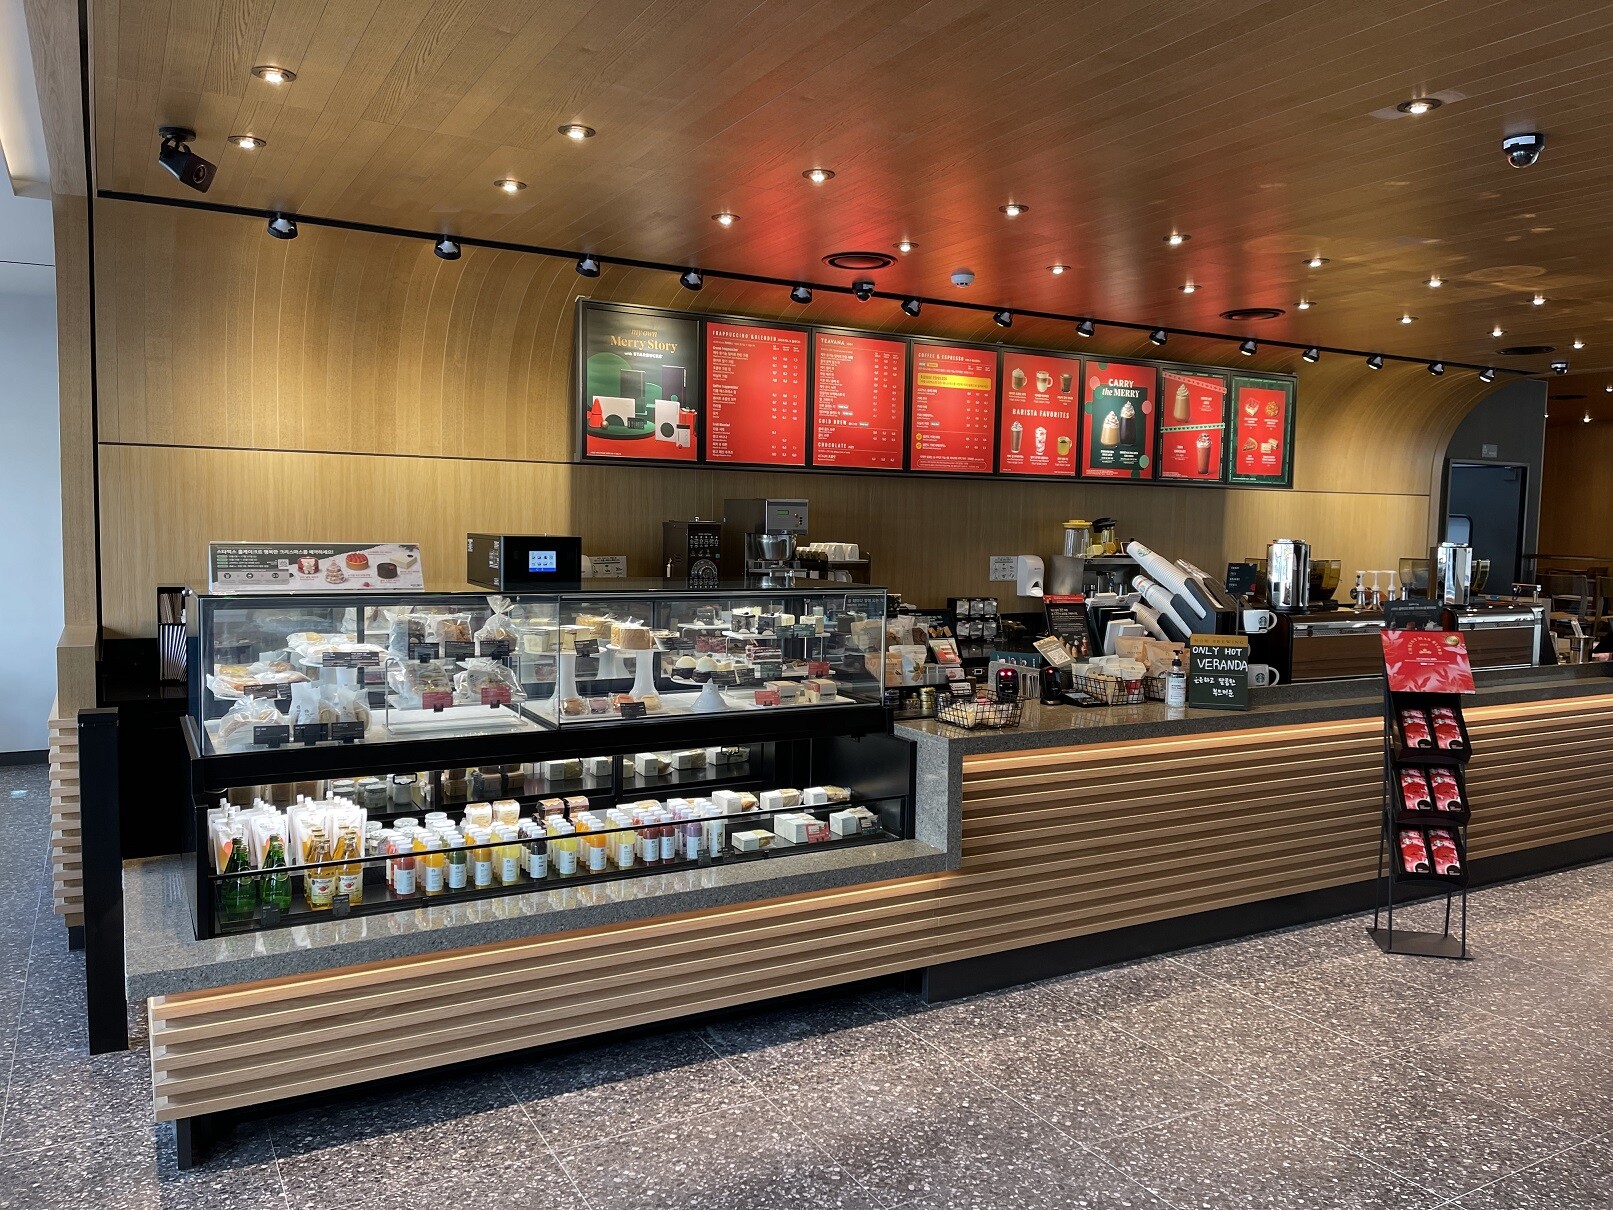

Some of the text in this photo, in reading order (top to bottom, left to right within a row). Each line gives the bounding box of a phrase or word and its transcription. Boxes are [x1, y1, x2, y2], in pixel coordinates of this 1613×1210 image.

[712, 330, 748, 339] FRAPPUCCINO
[610, 336, 678, 354] Merry Story
[820, 338, 844, 346] TEAVANA
[1108, 378, 1134, 388] CARRY
[1102, 388, 1140, 398] the MERRY
[1040, 410, 1070, 419] FAVORITES
[1192, 646, 1242, 656] ONLY HOT
[1197, 658, 1248, 672] VERANDA
